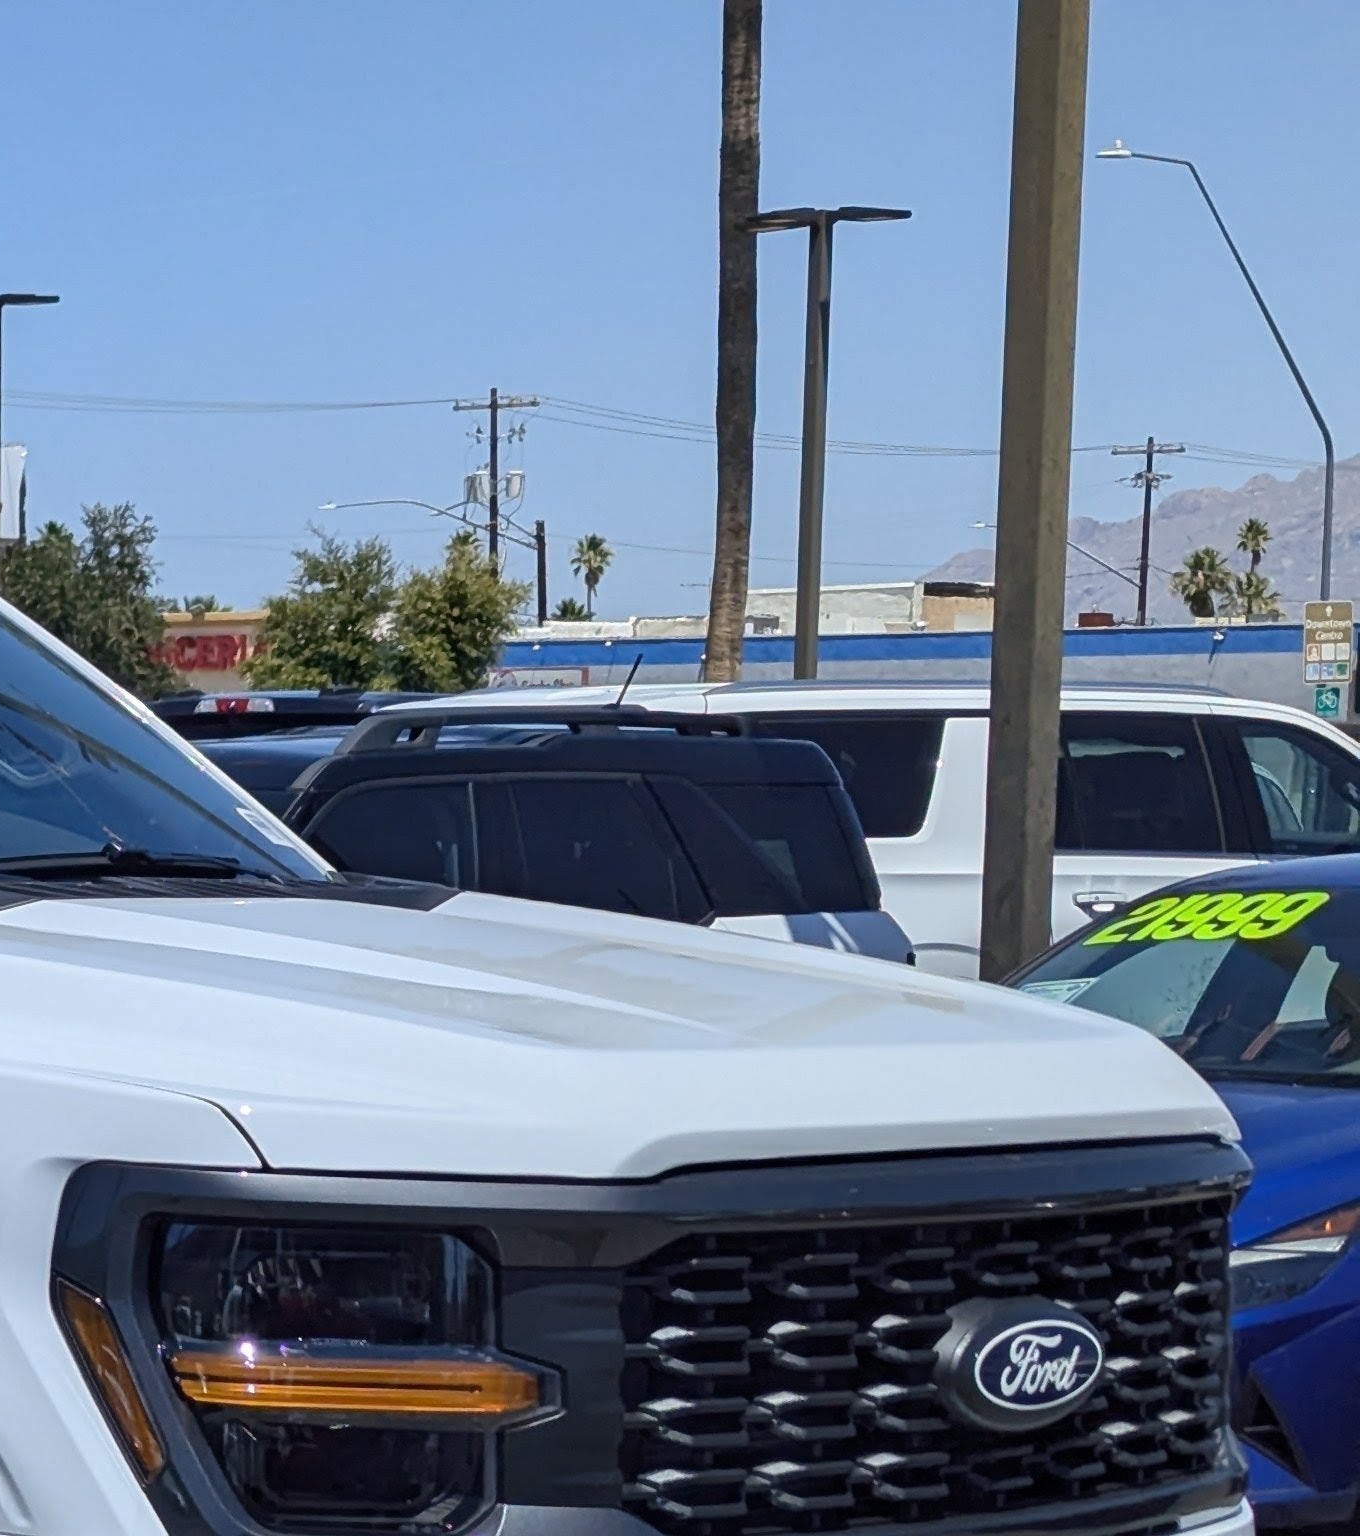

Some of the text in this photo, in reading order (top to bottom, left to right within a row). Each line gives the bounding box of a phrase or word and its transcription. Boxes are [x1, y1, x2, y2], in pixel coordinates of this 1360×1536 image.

[1306, 620, 1351, 629] Downtown
[1083, 891, 1330, 946] 21999
[1000, 1334, 1081, 1397] Ford
